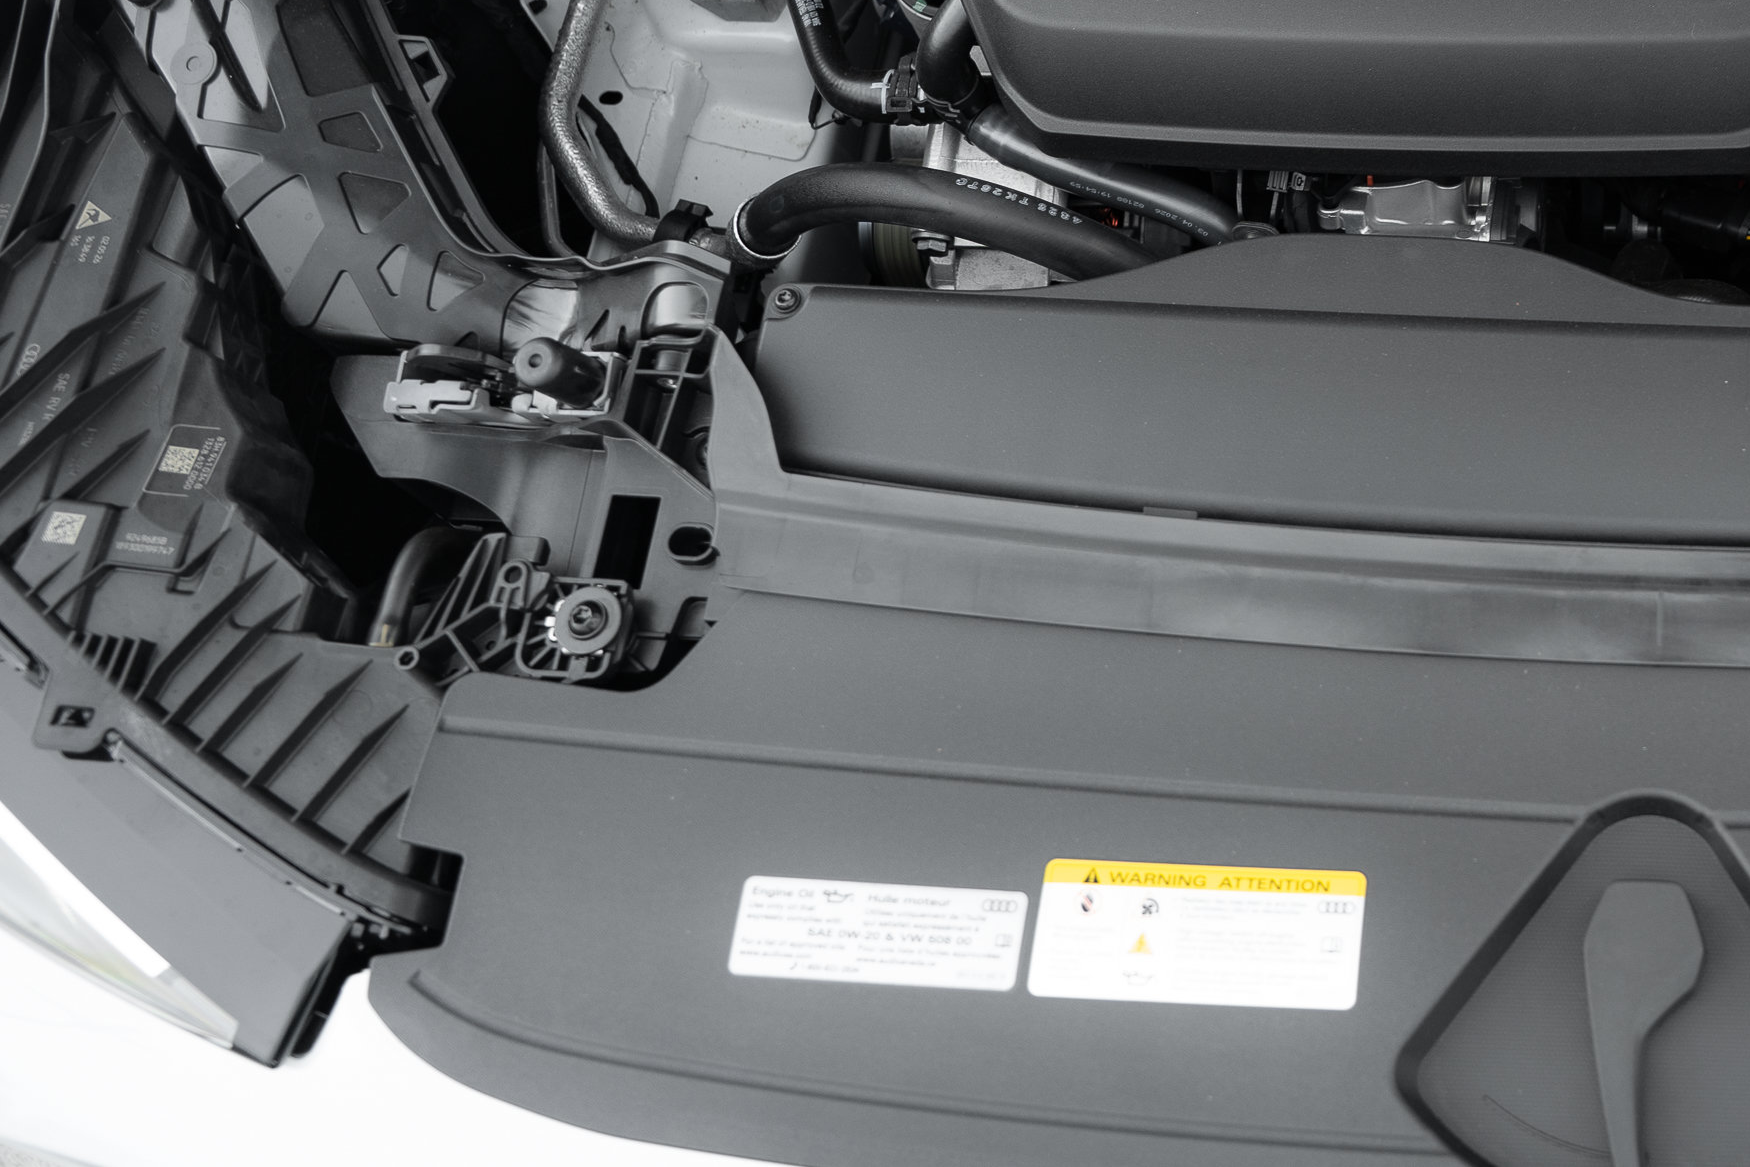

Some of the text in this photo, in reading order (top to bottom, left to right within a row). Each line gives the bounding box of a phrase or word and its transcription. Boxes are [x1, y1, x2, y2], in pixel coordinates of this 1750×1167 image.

[1109, 870, 1331, 892] WARNING ATTENTION
[752, 886, 815, 900] Engine Oil
[868, 894, 952, 906] Huile moteur
[808, 928, 833, 938] SAE
[901, 934, 925, 943] VW
